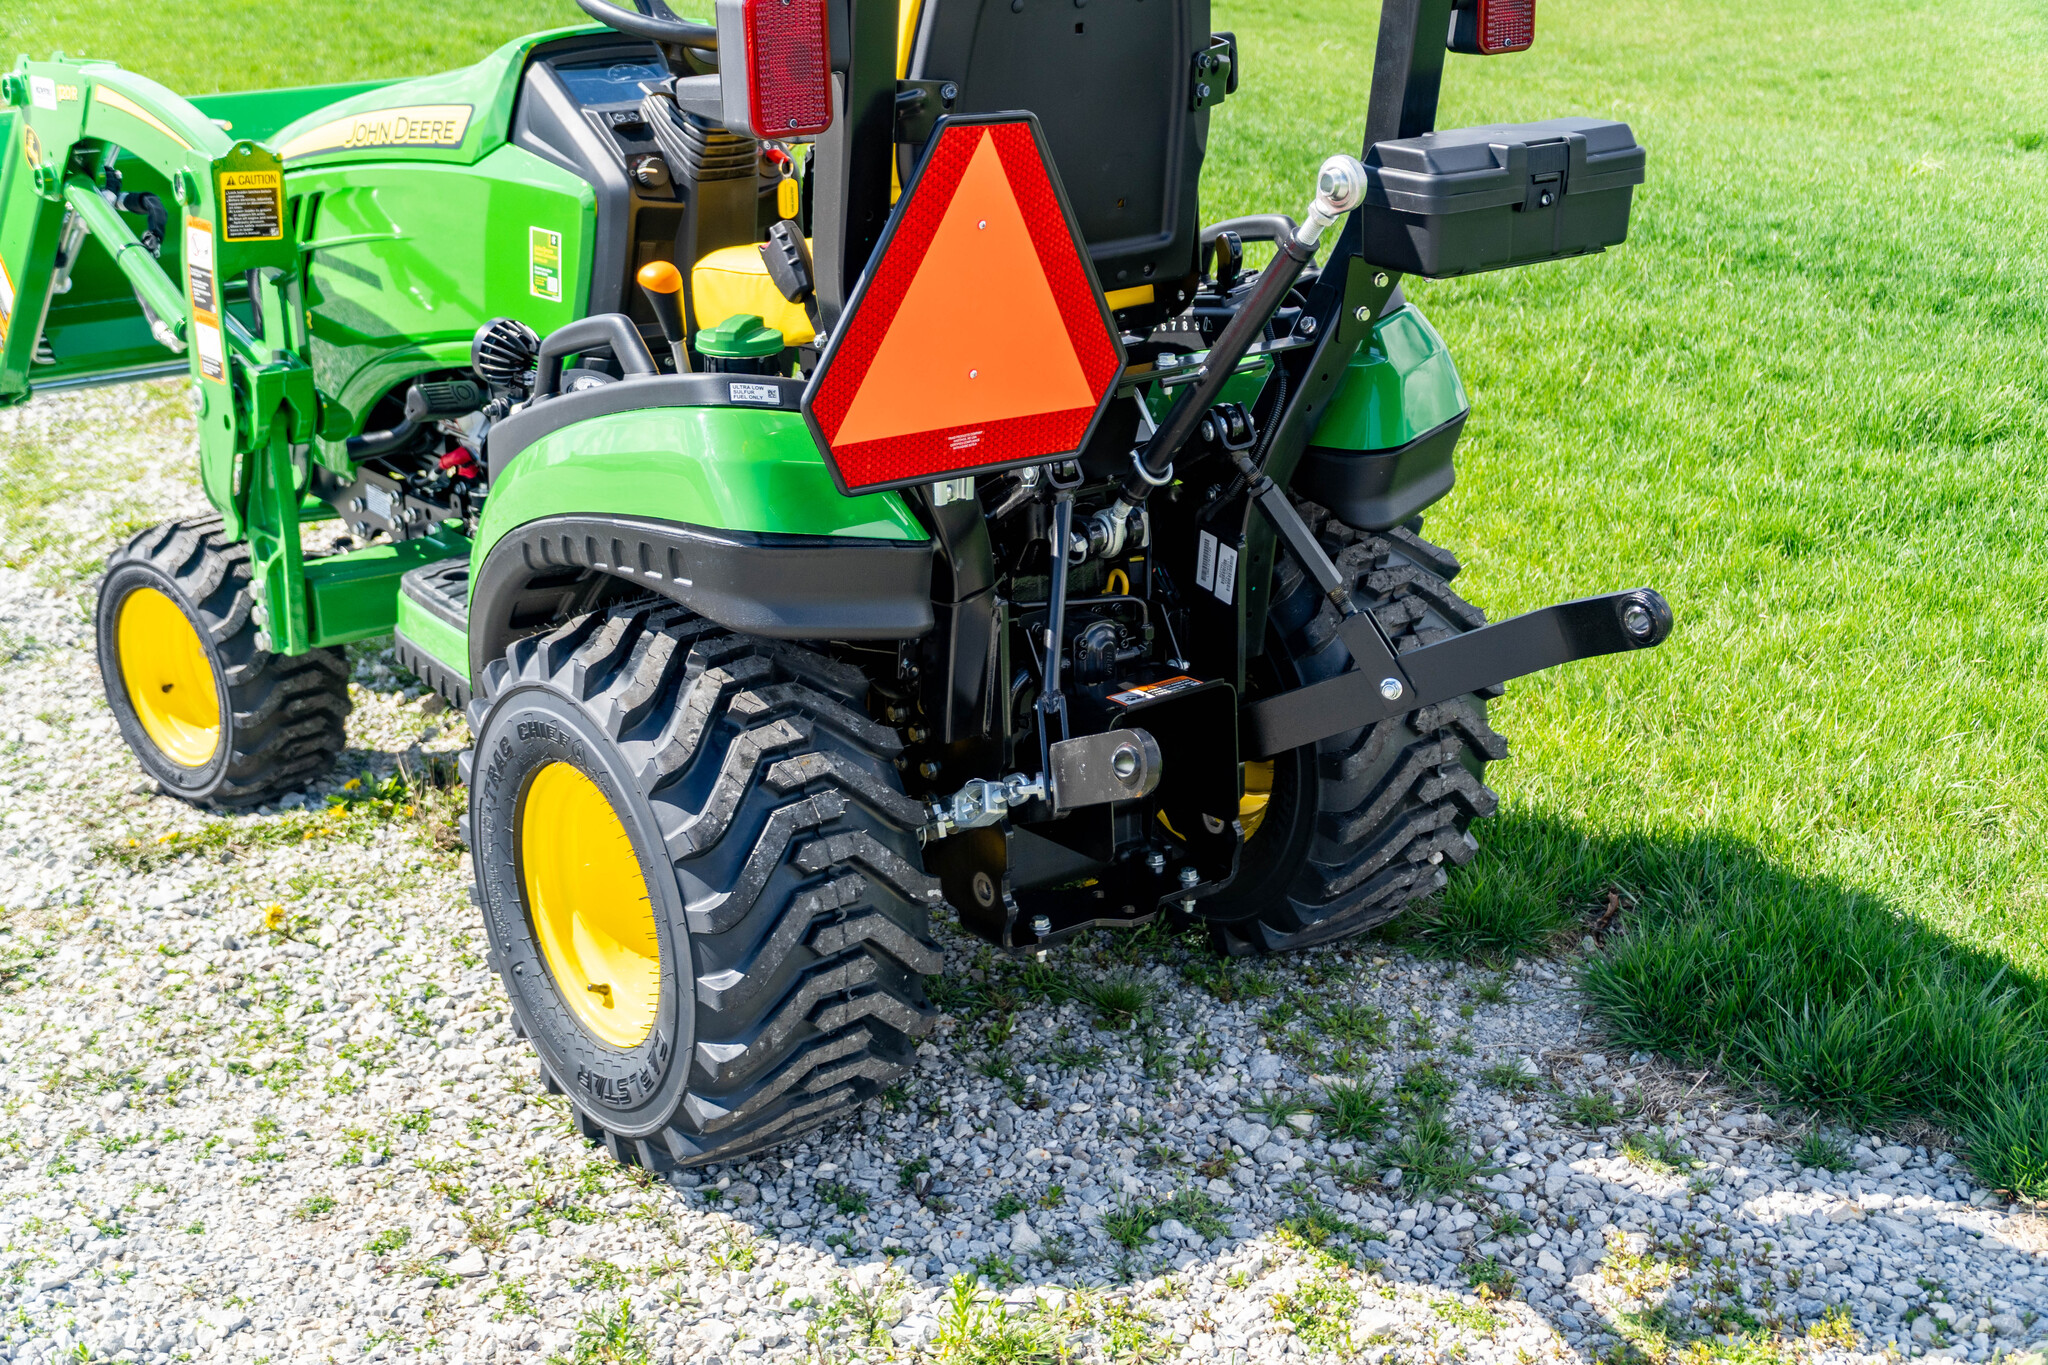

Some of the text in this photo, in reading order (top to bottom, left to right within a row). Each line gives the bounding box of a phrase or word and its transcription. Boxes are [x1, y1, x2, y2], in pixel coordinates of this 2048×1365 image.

[344, 116, 457, 147] JOHN DEERE
[238, 173, 277, 186] CAUTION
[1171, 321, 1177, 331] 7
[1182, 321, 1188, 331] 8
[483, 735, 516, 804] TRAC
[516, 720, 571, 749] CHIEF
